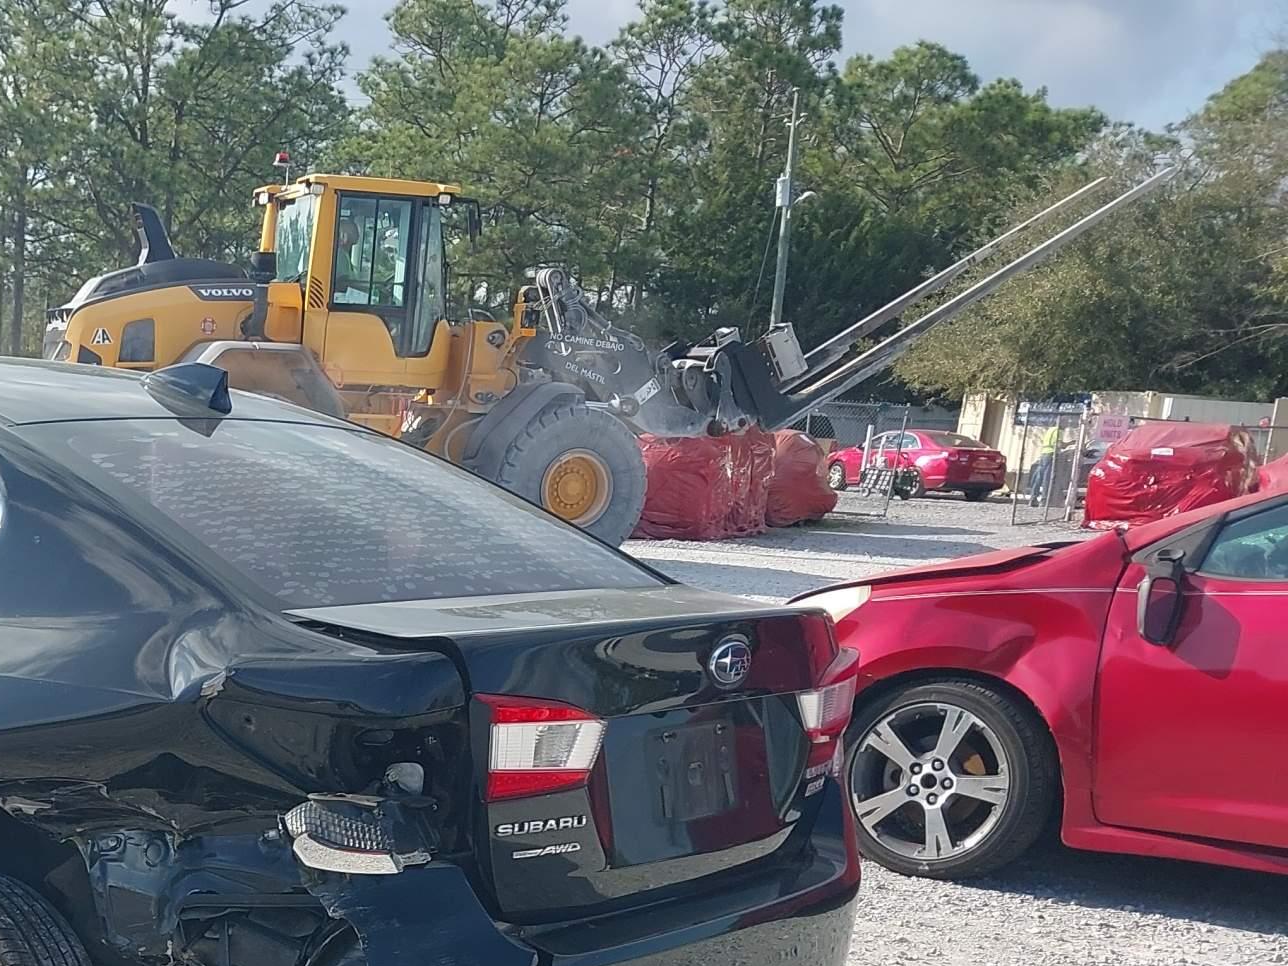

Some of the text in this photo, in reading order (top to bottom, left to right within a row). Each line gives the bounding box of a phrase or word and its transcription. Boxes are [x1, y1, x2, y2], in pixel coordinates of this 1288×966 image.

[198, 288, 253, 297] VOLVO
[550, 332, 625, 352] NO CAMINE DEBAJO
[564, 361, 579, 374] DEL
[495, 815, 587, 837] SUBARU
[540, 842, 581, 857] AWD
